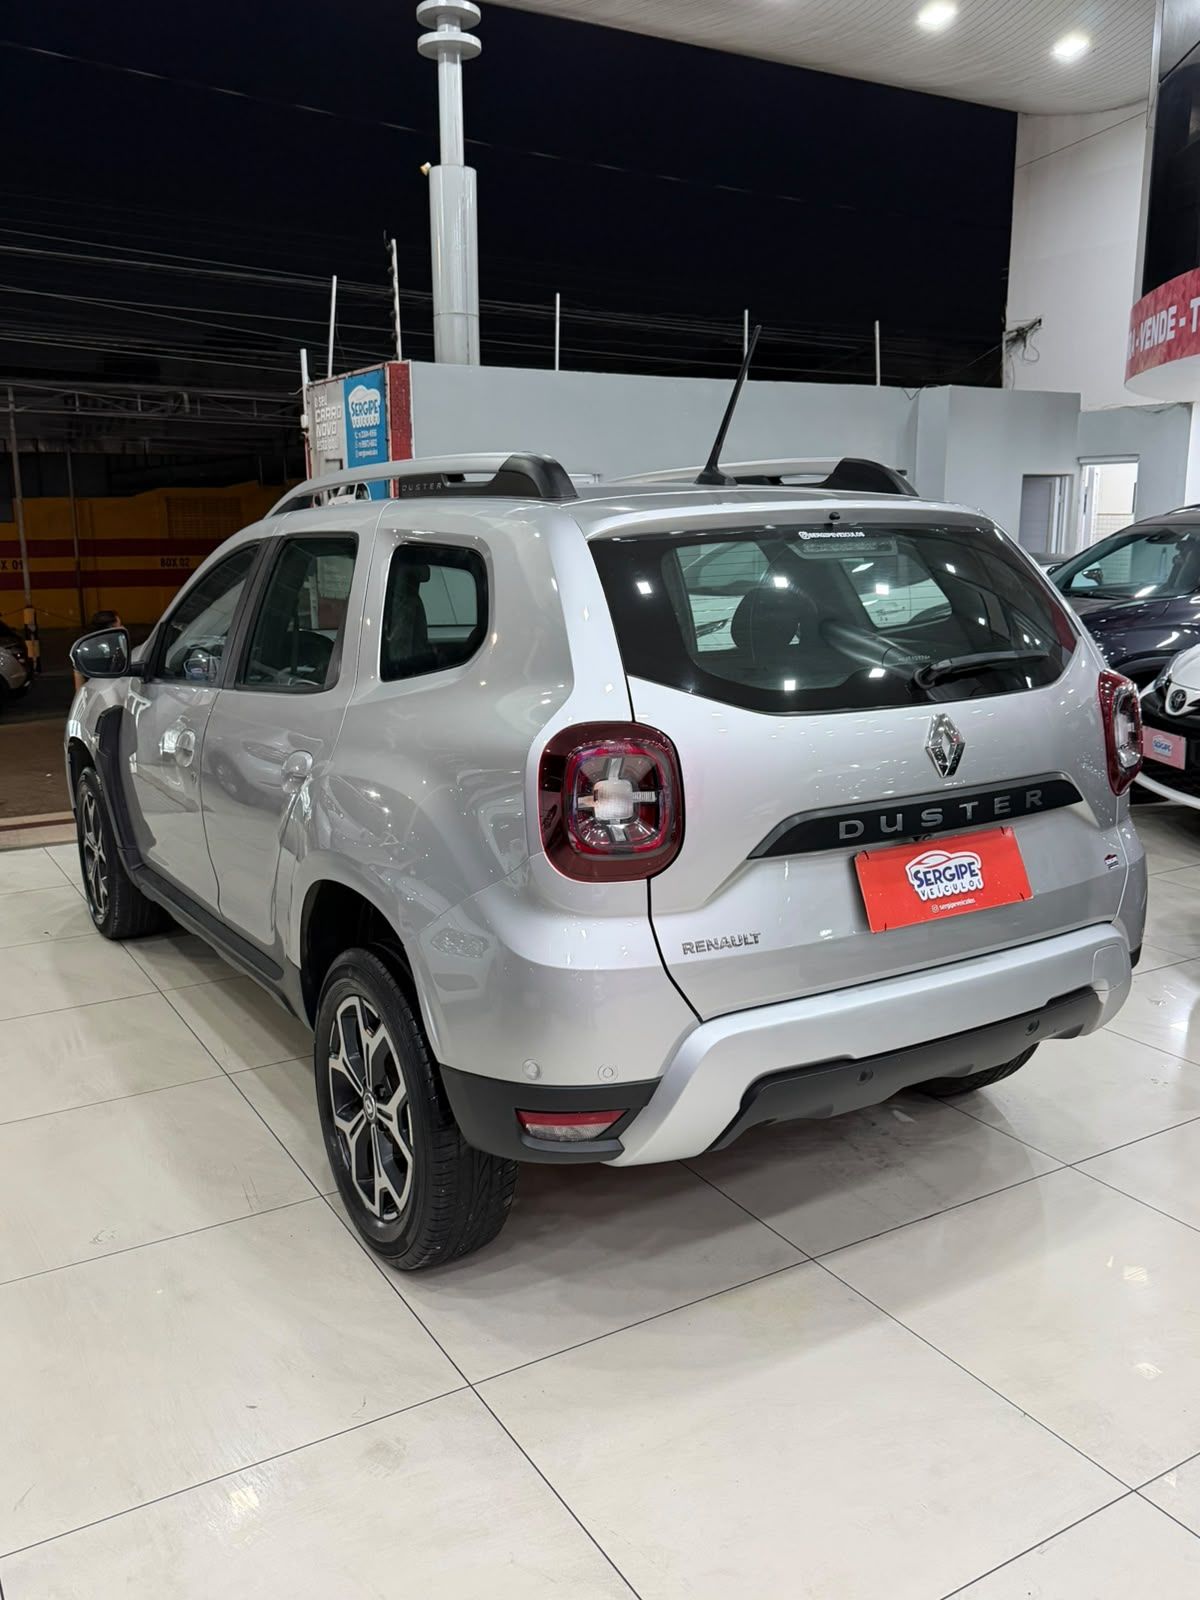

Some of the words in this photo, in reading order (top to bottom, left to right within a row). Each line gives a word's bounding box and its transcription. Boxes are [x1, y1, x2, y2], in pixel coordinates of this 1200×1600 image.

[351, 399, 379, 417] SERGIPE
[316, 421, 337, 438] NOVO
[401, 482, 442, 491] DUSTER
[160, 558, 178, 568] BOX
[838, 789, 1043, 840] DUSTER
[913, 862, 979, 888] SERGIPE
[681, 932, 761, 955] RENAULT
